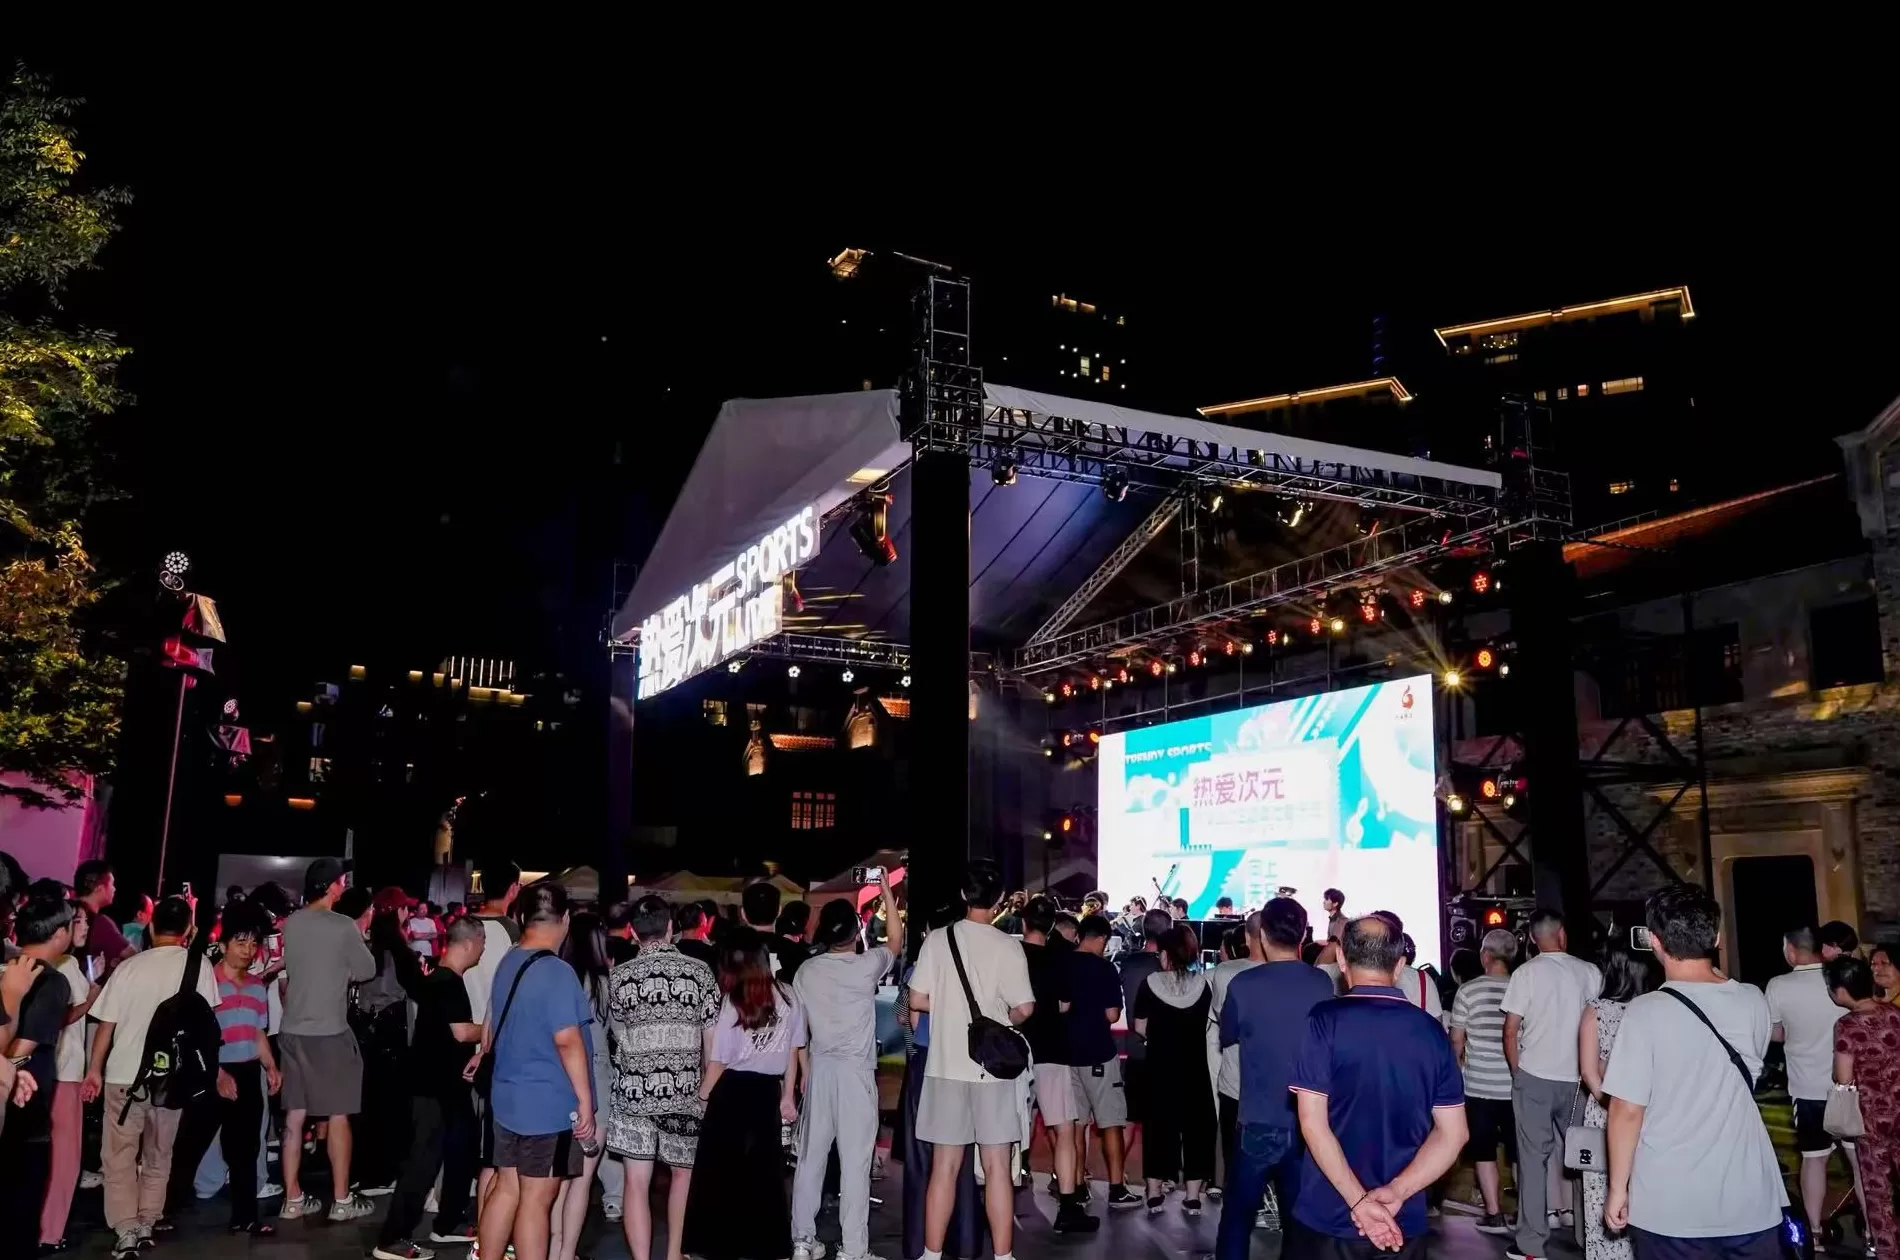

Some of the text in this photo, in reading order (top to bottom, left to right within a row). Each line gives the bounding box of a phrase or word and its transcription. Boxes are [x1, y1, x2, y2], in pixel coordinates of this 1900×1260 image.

[736, 506, 814, 599] SPORTS
[1192, 767, 1285, 807] 热爱次元
